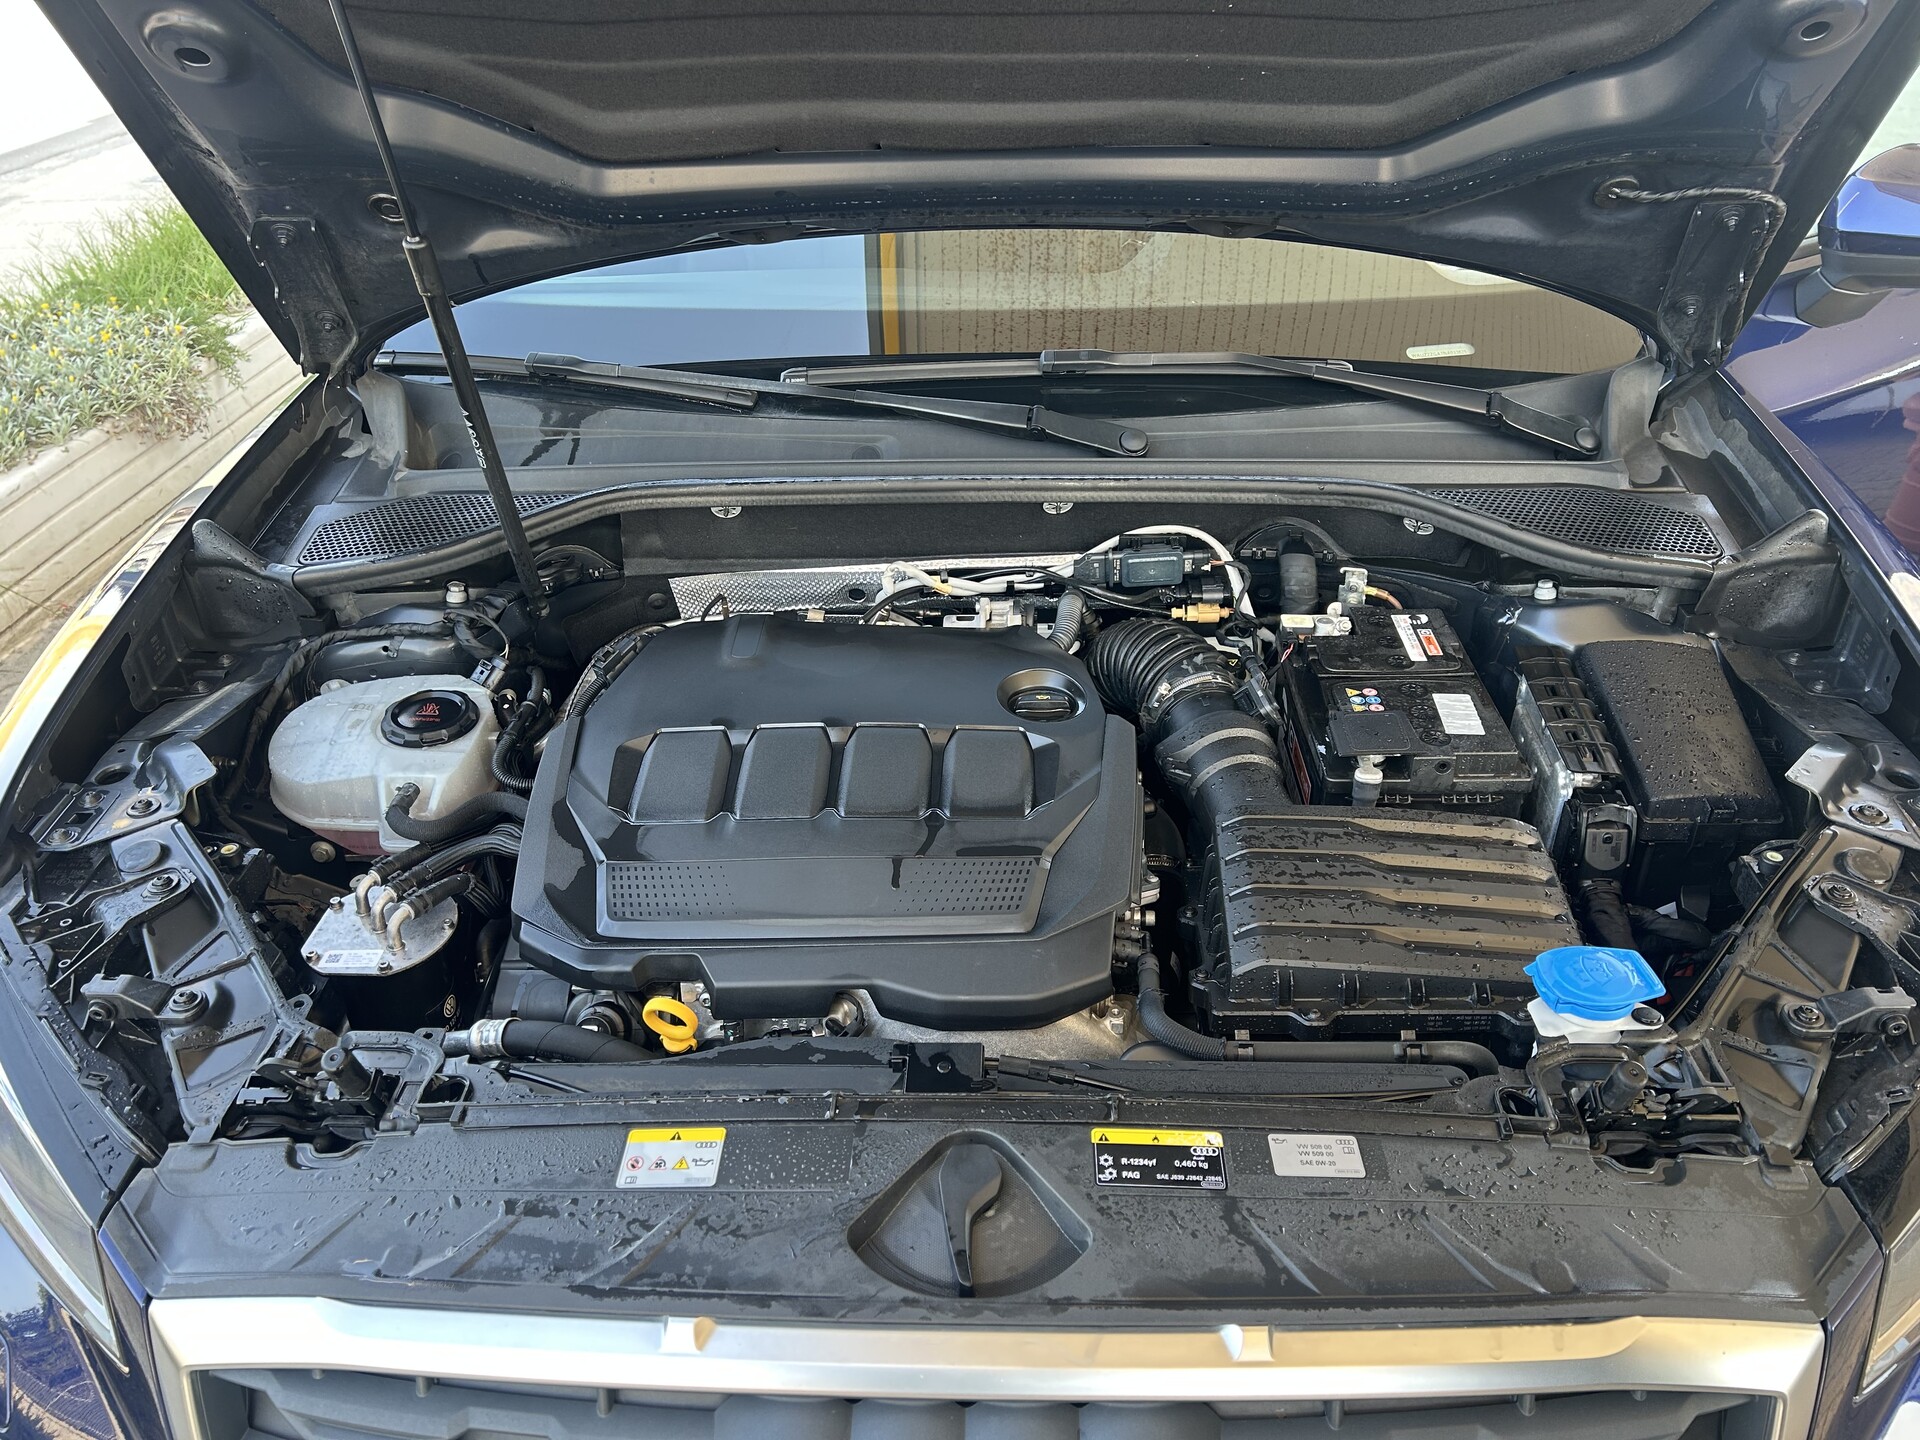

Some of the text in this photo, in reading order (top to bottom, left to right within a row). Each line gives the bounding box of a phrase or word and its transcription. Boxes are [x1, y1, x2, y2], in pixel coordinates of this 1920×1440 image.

[1121, 1158, 1156, 1167] R-1234yf
[1198, 1160, 1208, 1169] kg
[1122, 1171, 1140, 1179] PAG
